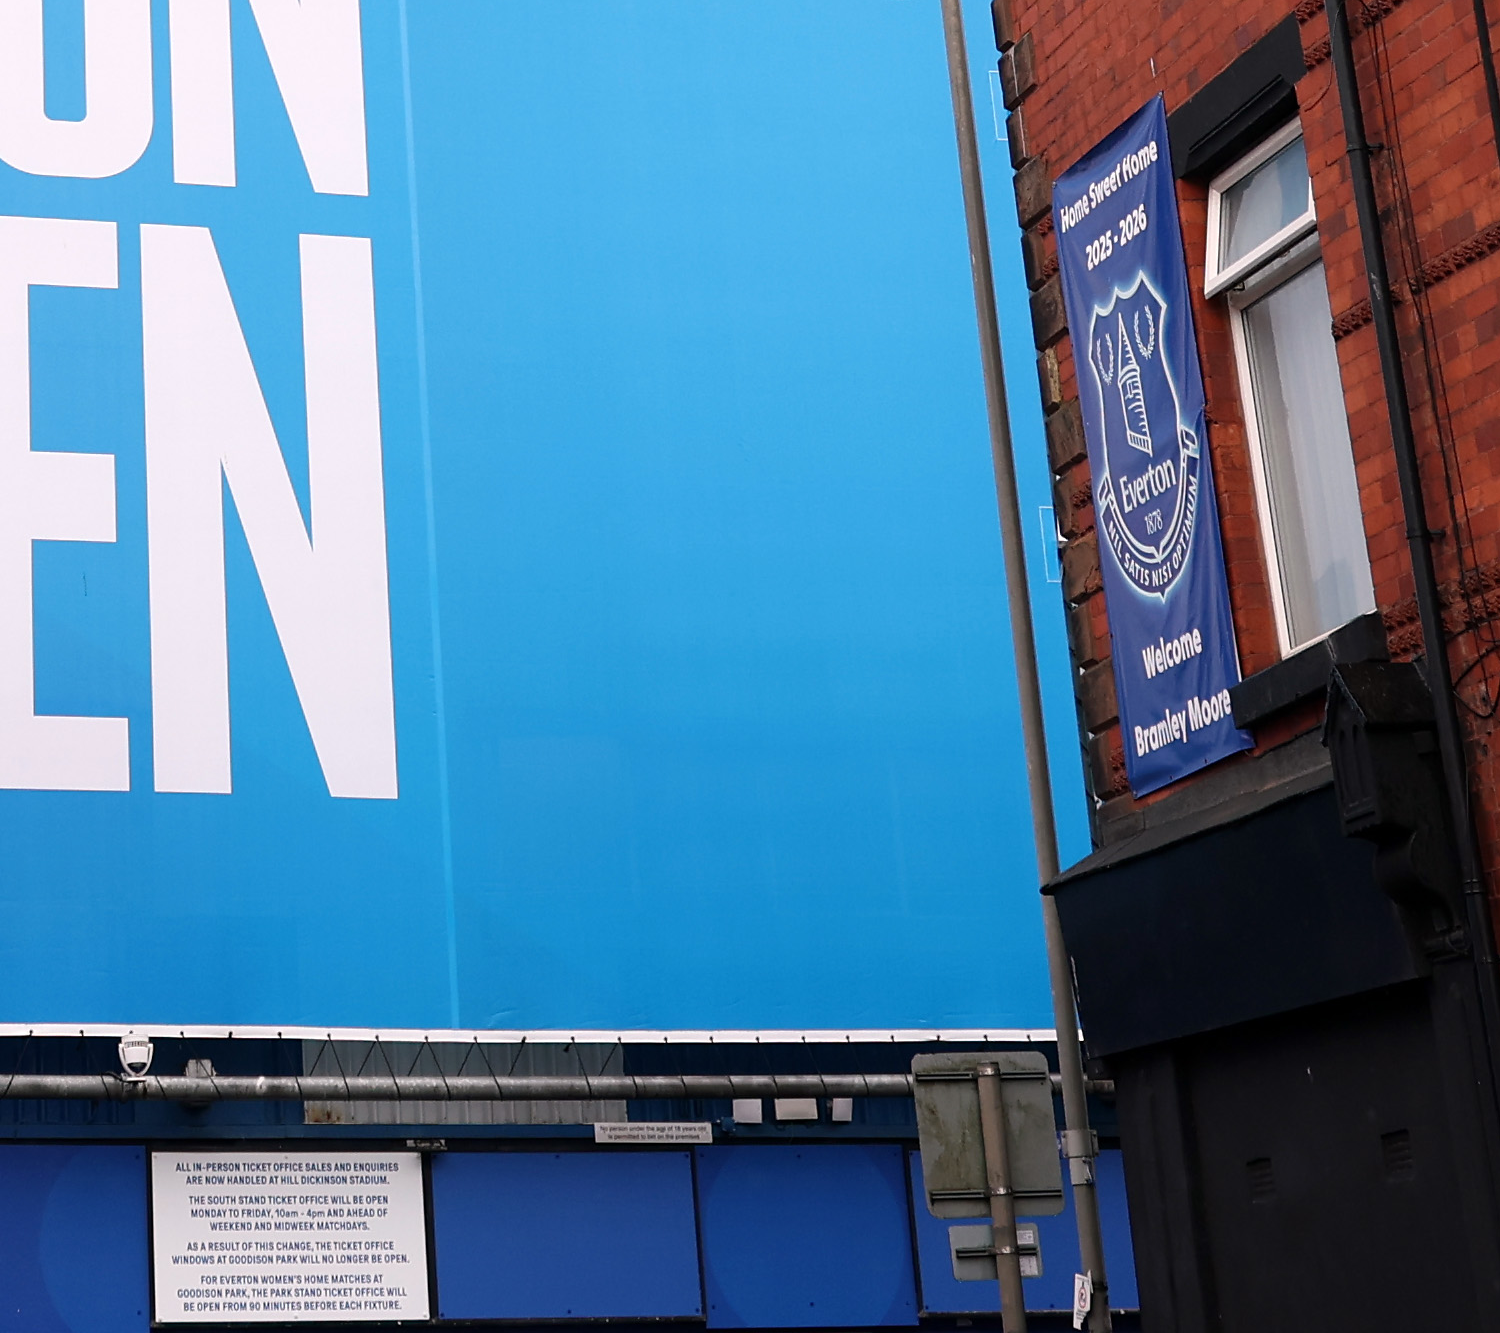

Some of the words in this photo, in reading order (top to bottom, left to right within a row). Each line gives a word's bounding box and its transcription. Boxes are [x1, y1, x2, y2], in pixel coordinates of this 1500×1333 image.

[1060, 194, 1090, 233] Home
[1088, 163, 1122, 209] Sweet
[1122, 141, 1158, 182] Home
[1086, 230, 1112, 271] 2025
[1119, 204, 1147, 246] 2026
[1119, 459, 1176, 513] Everton
[1109, 520, 1122, 558] NIL
[1124, 554, 1149, 586] SATIS
[1152, 562, 1172, 587] NISI
[1173, 475, 1197, 569] OPTIMUM
[1145, 509, 1163, 535] 1878
[1142, 628, 1202, 679] Welcome
[1134, 708, 1187, 757] Bramley
[1188, 688, 1231, 731] Moore
[175, 1162, 191, 1172] ALL
[192, 1162, 240, 1172] IN-PERSON
[242, 1162, 271, 1172] TICKET
[273, 1162, 303, 1172] OFFICE
[305, 1162, 332, 1172] SALES
[334, 1162, 351, 1172] AND
[354, 1162, 399, 1172] ENQUIRIES
[186, 1175, 203, 1185] ARE
[205, 1175, 225, 1185] NOW
[227, 1175, 267, 1185] HANDLED
[269, 1175, 279, 1185] AT
[281, 1175, 299, 1185] HILL
[301, 1175, 347, 1185] DICKINSON
[350, 1175, 390, 1185] STADIUM.
[189, 1195, 205, 1205] THE
[207, 1195, 236, 1205] SOUTH
[238, 1195, 266, 1205] STAND
[268, 1195, 297, 1205] TICKET
[299, 1195, 329, 1205] OFFICE
[330, 1195, 350, 1205] WILL
[353, 1195, 364, 1205] BE
[366, 1195, 388, 1205] OPEN
[191, 1209, 227, 1218] MONDAY
[229, 1209, 239, 1218] TO
[241, 1209, 274, 1219] FRIDAY,
[276, 1209, 298, 1218] 10am
[306, 1209, 325, 1220] 4pm
[327, 1209, 344, 1218] AND
[346, 1209, 374, 1218] AHEAD
[377, 1209, 388, 1218] OF
[210, 1222, 252, 1231] WEEKEND
[255, 1222, 272, 1231] AND
[274, 1222, 315, 1231] MIDWEEK
[317, 1222, 370, 1231] MATCHDAYS.
[187, 1241, 198, 1251] AS
[200, 1241, 207, 1251] A
[209, 1241, 240, 1251] RESULT
[242, 1241, 253, 1251] OF
[255, 1241, 274, 1251] THIS
[276, 1241, 314, 1252] CHANGE,
[315, 1241, 332, 1251] THE
[333, 1241, 363, 1251] TICKET
[364, 1241, 394, 1251] OFFICE
[172, 1255, 215, 1265] WINDOWS
[217, 1255, 226, 1265] AT
[228, 1255, 274, 1265] GOODISON
[276, 1255, 298, 1265] PARK
[299, 1255, 320, 1265] WILL
[322, 1255, 334, 1265] NO
[336, 1255, 369, 1265] LONGER
[372, 1255, 382, 1265] BE
[384, 1255, 410, 1265] OPEN.
